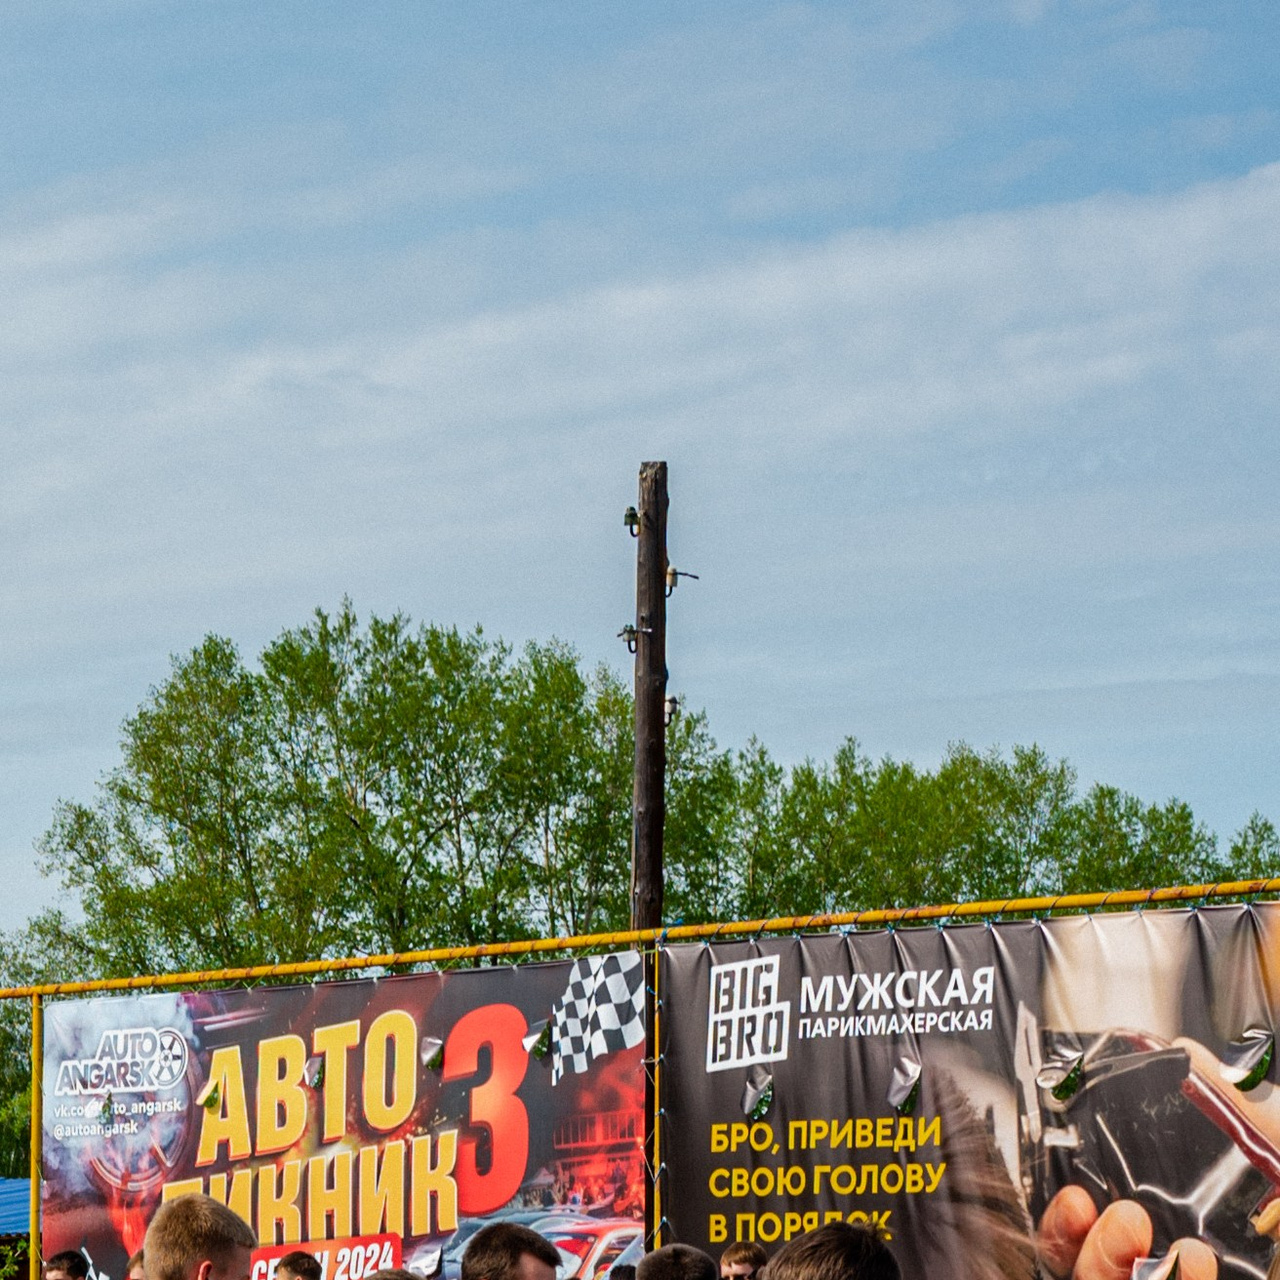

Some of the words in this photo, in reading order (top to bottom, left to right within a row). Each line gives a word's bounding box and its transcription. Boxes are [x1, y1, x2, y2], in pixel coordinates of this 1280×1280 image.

[715, 962, 775, 1014] BIG
[800, 966, 995, 1014] МУЖСКАЯ
[712, 1009, 783, 1064] BRO
[798, 1009, 993, 1039] ПАРИКМАХЕРСКАЯ
[98, 1031, 158, 1060] AUTO
[55, 1061, 157, 1092] ANGARSK
[195, 1009, 418, 1167] АВТО
[444, 1002, 530, 1217] 3
[53, 1120, 139, 1140] @autoangarsk
[710, 1122, 780, 1155] БРО,
[788, 1116, 941, 1152] ПРИВЕДИ
[709, 1164, 806, 1198] СВОЮ
[813, 1162, 947, 1195] ГОЛОВУ
[709, 1214, 728, 1243] В
